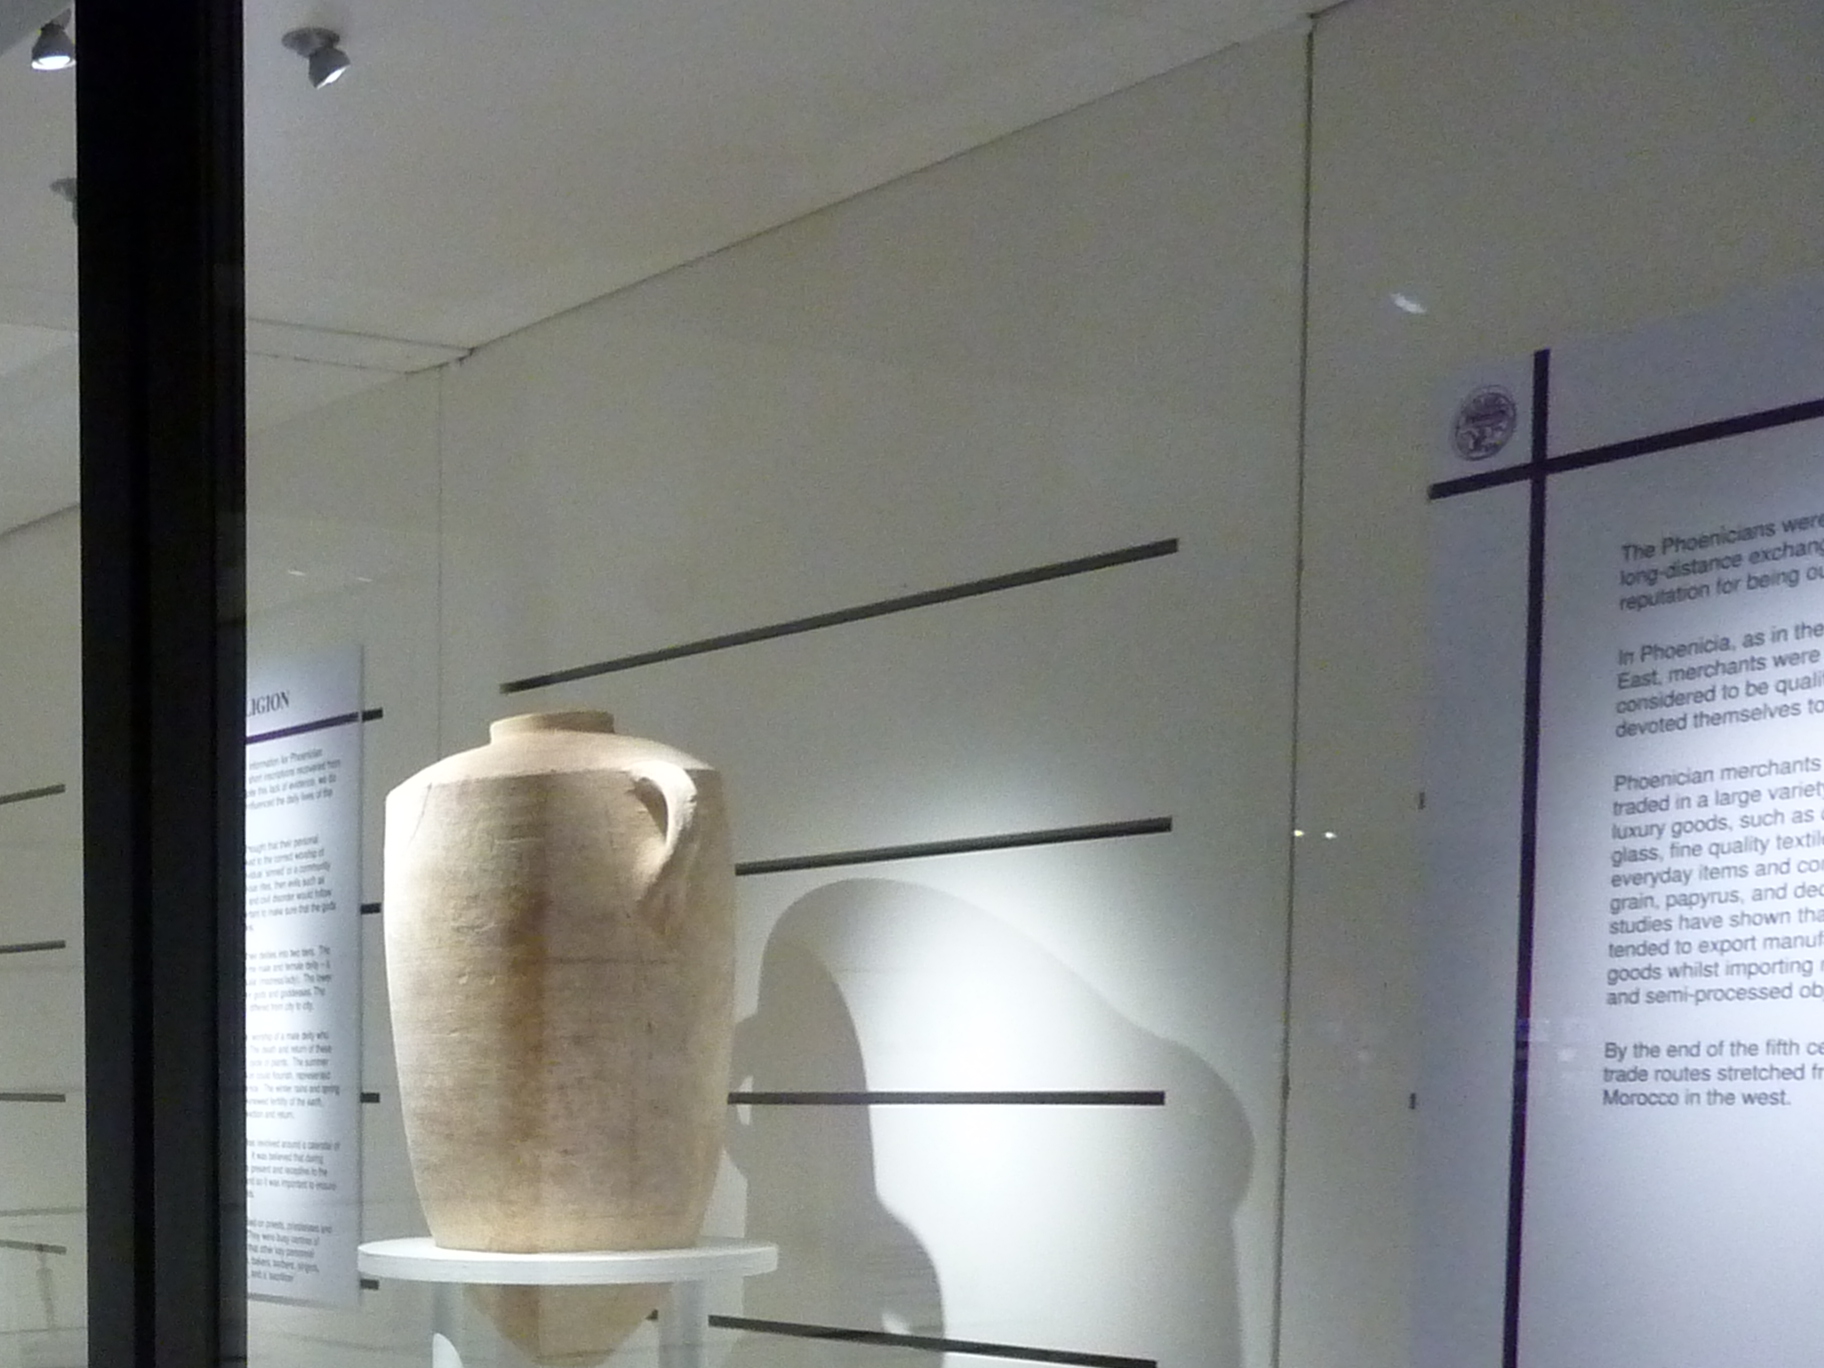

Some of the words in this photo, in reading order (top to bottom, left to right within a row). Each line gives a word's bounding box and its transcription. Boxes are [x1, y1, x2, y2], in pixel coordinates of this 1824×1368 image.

[1624, 539, 1656, 561] The
[1661, 522, 1776, 554] Phoenicians
[1620, 554, 1743, 586] long-distance
[1619, 582, 1710, 613] reputation
[1715, 576, 1741, 596] for
[1746, 568, 1801, 591] being
[1618, 646, 1634, 666] In
[1640, 633, 1740, 662] Phoenicia,
[1742, 632, 1765, 648] as
[1770, 626, 1788, 645] in
[1617, 666, 1663, 688] East,
[1668, 653, 1767, 681] merchants
[1772, 649, 1820, 668] were
[1616, 683, 1716, 713] considered
[1722, 683, 1740, 701] to
[1745, 678, 1769, 698] be
[1775, 670, 1824, 699] quali
[1615, 711, 1687, 739] devoted
[1692, 700, 1801, 729] themselves
[1614, 765, 1714, 791] Phoenician
[1720, 756, 1821, 781] merchants
[1613, 791, 1670, 816] traded
[1675, 791, 1691, 810] in
[1697, 794, 1708, 808] a
[1715, 787, 1762, 809] large
[1611, 820, 1665, 840] luxury
[1671, 811, 1733, 839] goods,
[1740, 805, 1785, 828] such
[1792, 808, 1814, 823] as
[1611, 843, 1665, 869] glass,
[1670, 839, 1703, 859] fine
[1708, 834, 1769, 861] quality
[1776, 828, 1824, 851] textil
[1611, 864, 1692, 889] everyday
[1698, 862, 1748, 881] items
[1755, 855, 1791, 877] and
[1797, 858, 1824, 874] co
[1610, 890, 1660, 916] grain,
[1665, 889, 1745, 913] papyrus,
[1752, 881, 1787, 902] and
[1609, 912, 1672, 933] studies
[1678, 910, 1723, 930] have
[1729, 907, 1791, 928] shown
[1608, 935, 1670, 957] tended
[1675, 936, 1692, 954] to
[1698, 933, 1756, 957] export
[1607, 959, 1662, 985] goods
[1668, 957, 1719, 978] whilst
[1725, 955, 1813, 981] importing
[1606, 984, 1640, 1005] and
[1645, 980, 1793, 1007] semi-processed
[1799, 979, 1824, 999] ob
[1604, 1038, 1627, 1063] By
[1633, 1038, 1661, 1058] the
[1666, 1037, 1701, 1058] end
[1706, 1037, 1724, 1057] of
[1730, 1037, 1759, 1057] the
[1766, 1036, 1800, 1057] fifth
[1603, 1061, 1648, 1081] trade
[1654, 1063, 1711, 1081] routes
[1717, 1060, 1805, 1081] stretched
[1603, 1085, 1679, 1105] Morocco
[1685, 1086, 1701, 1105] in
[1706, 1085, 1735, 1105] the
[1742, 1087, 1791, 1105] west.
